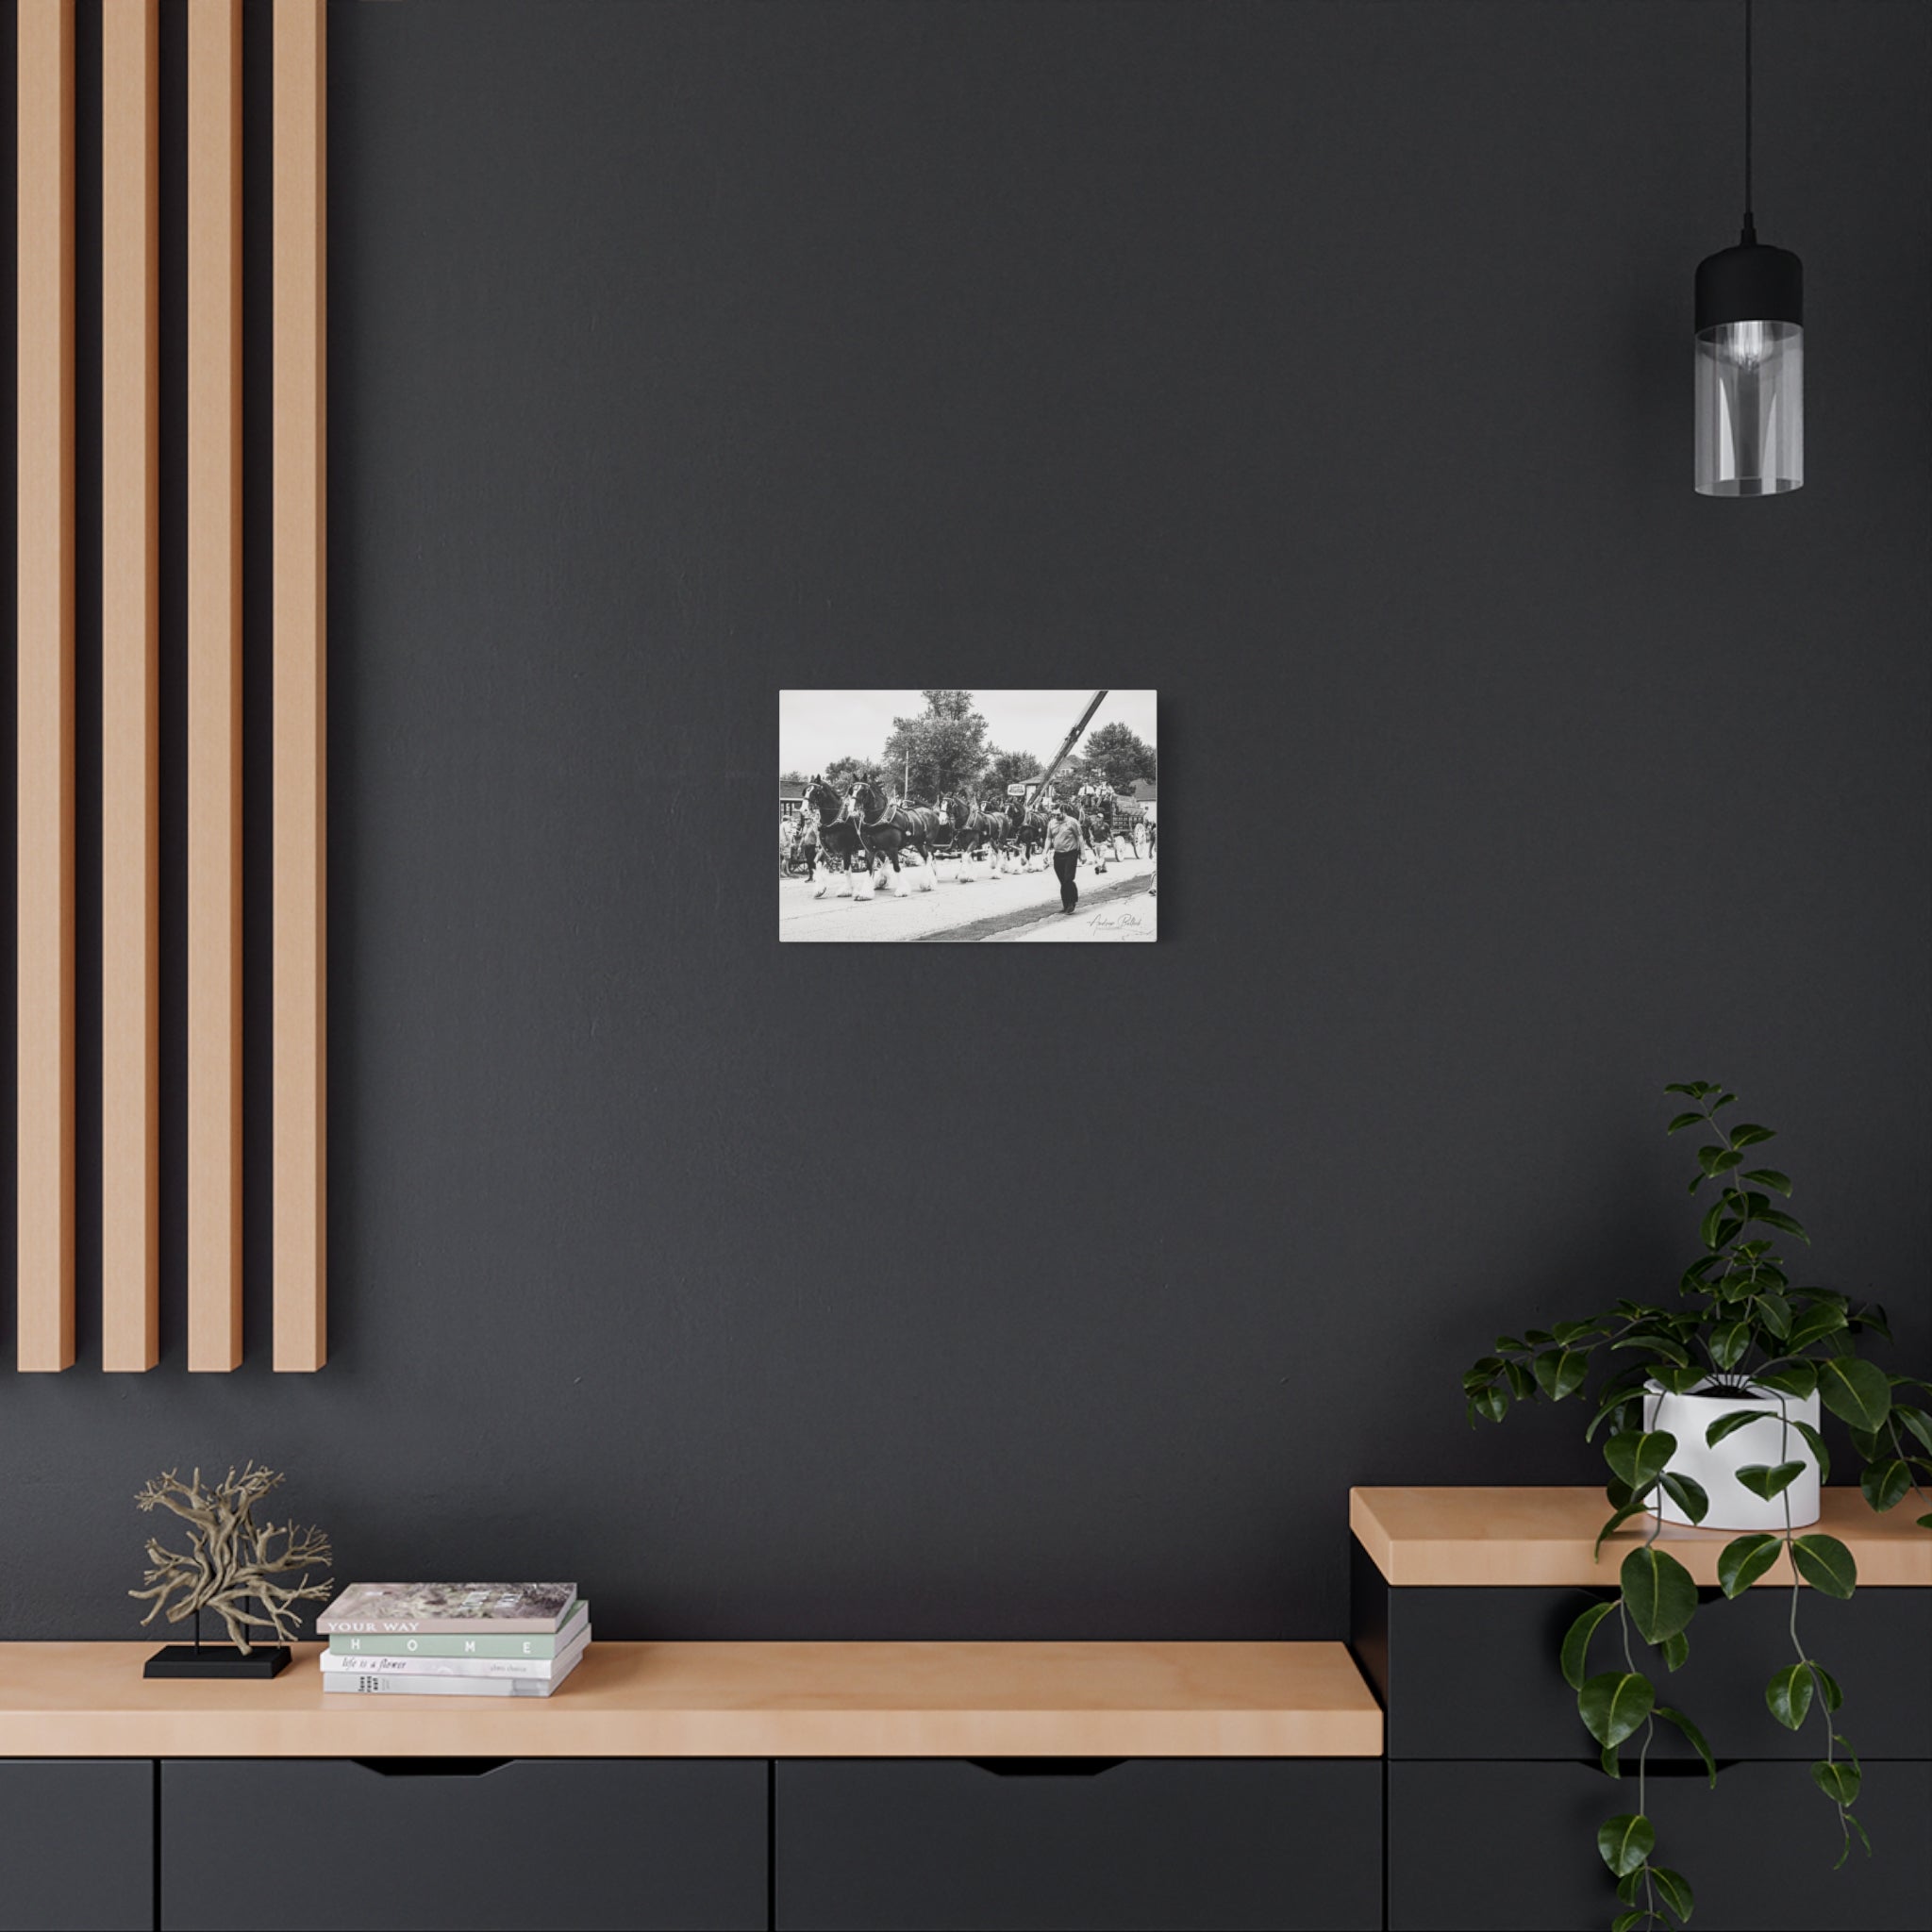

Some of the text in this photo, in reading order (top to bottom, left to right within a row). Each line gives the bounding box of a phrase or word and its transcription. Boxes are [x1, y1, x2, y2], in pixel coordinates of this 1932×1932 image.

[328, 1622, 420, 1632] YOUR WAY
[341, 1656, 357, 1671] life
[359, 1658, 367, 1669] is
[378, 1657, 408, 1672] flower
